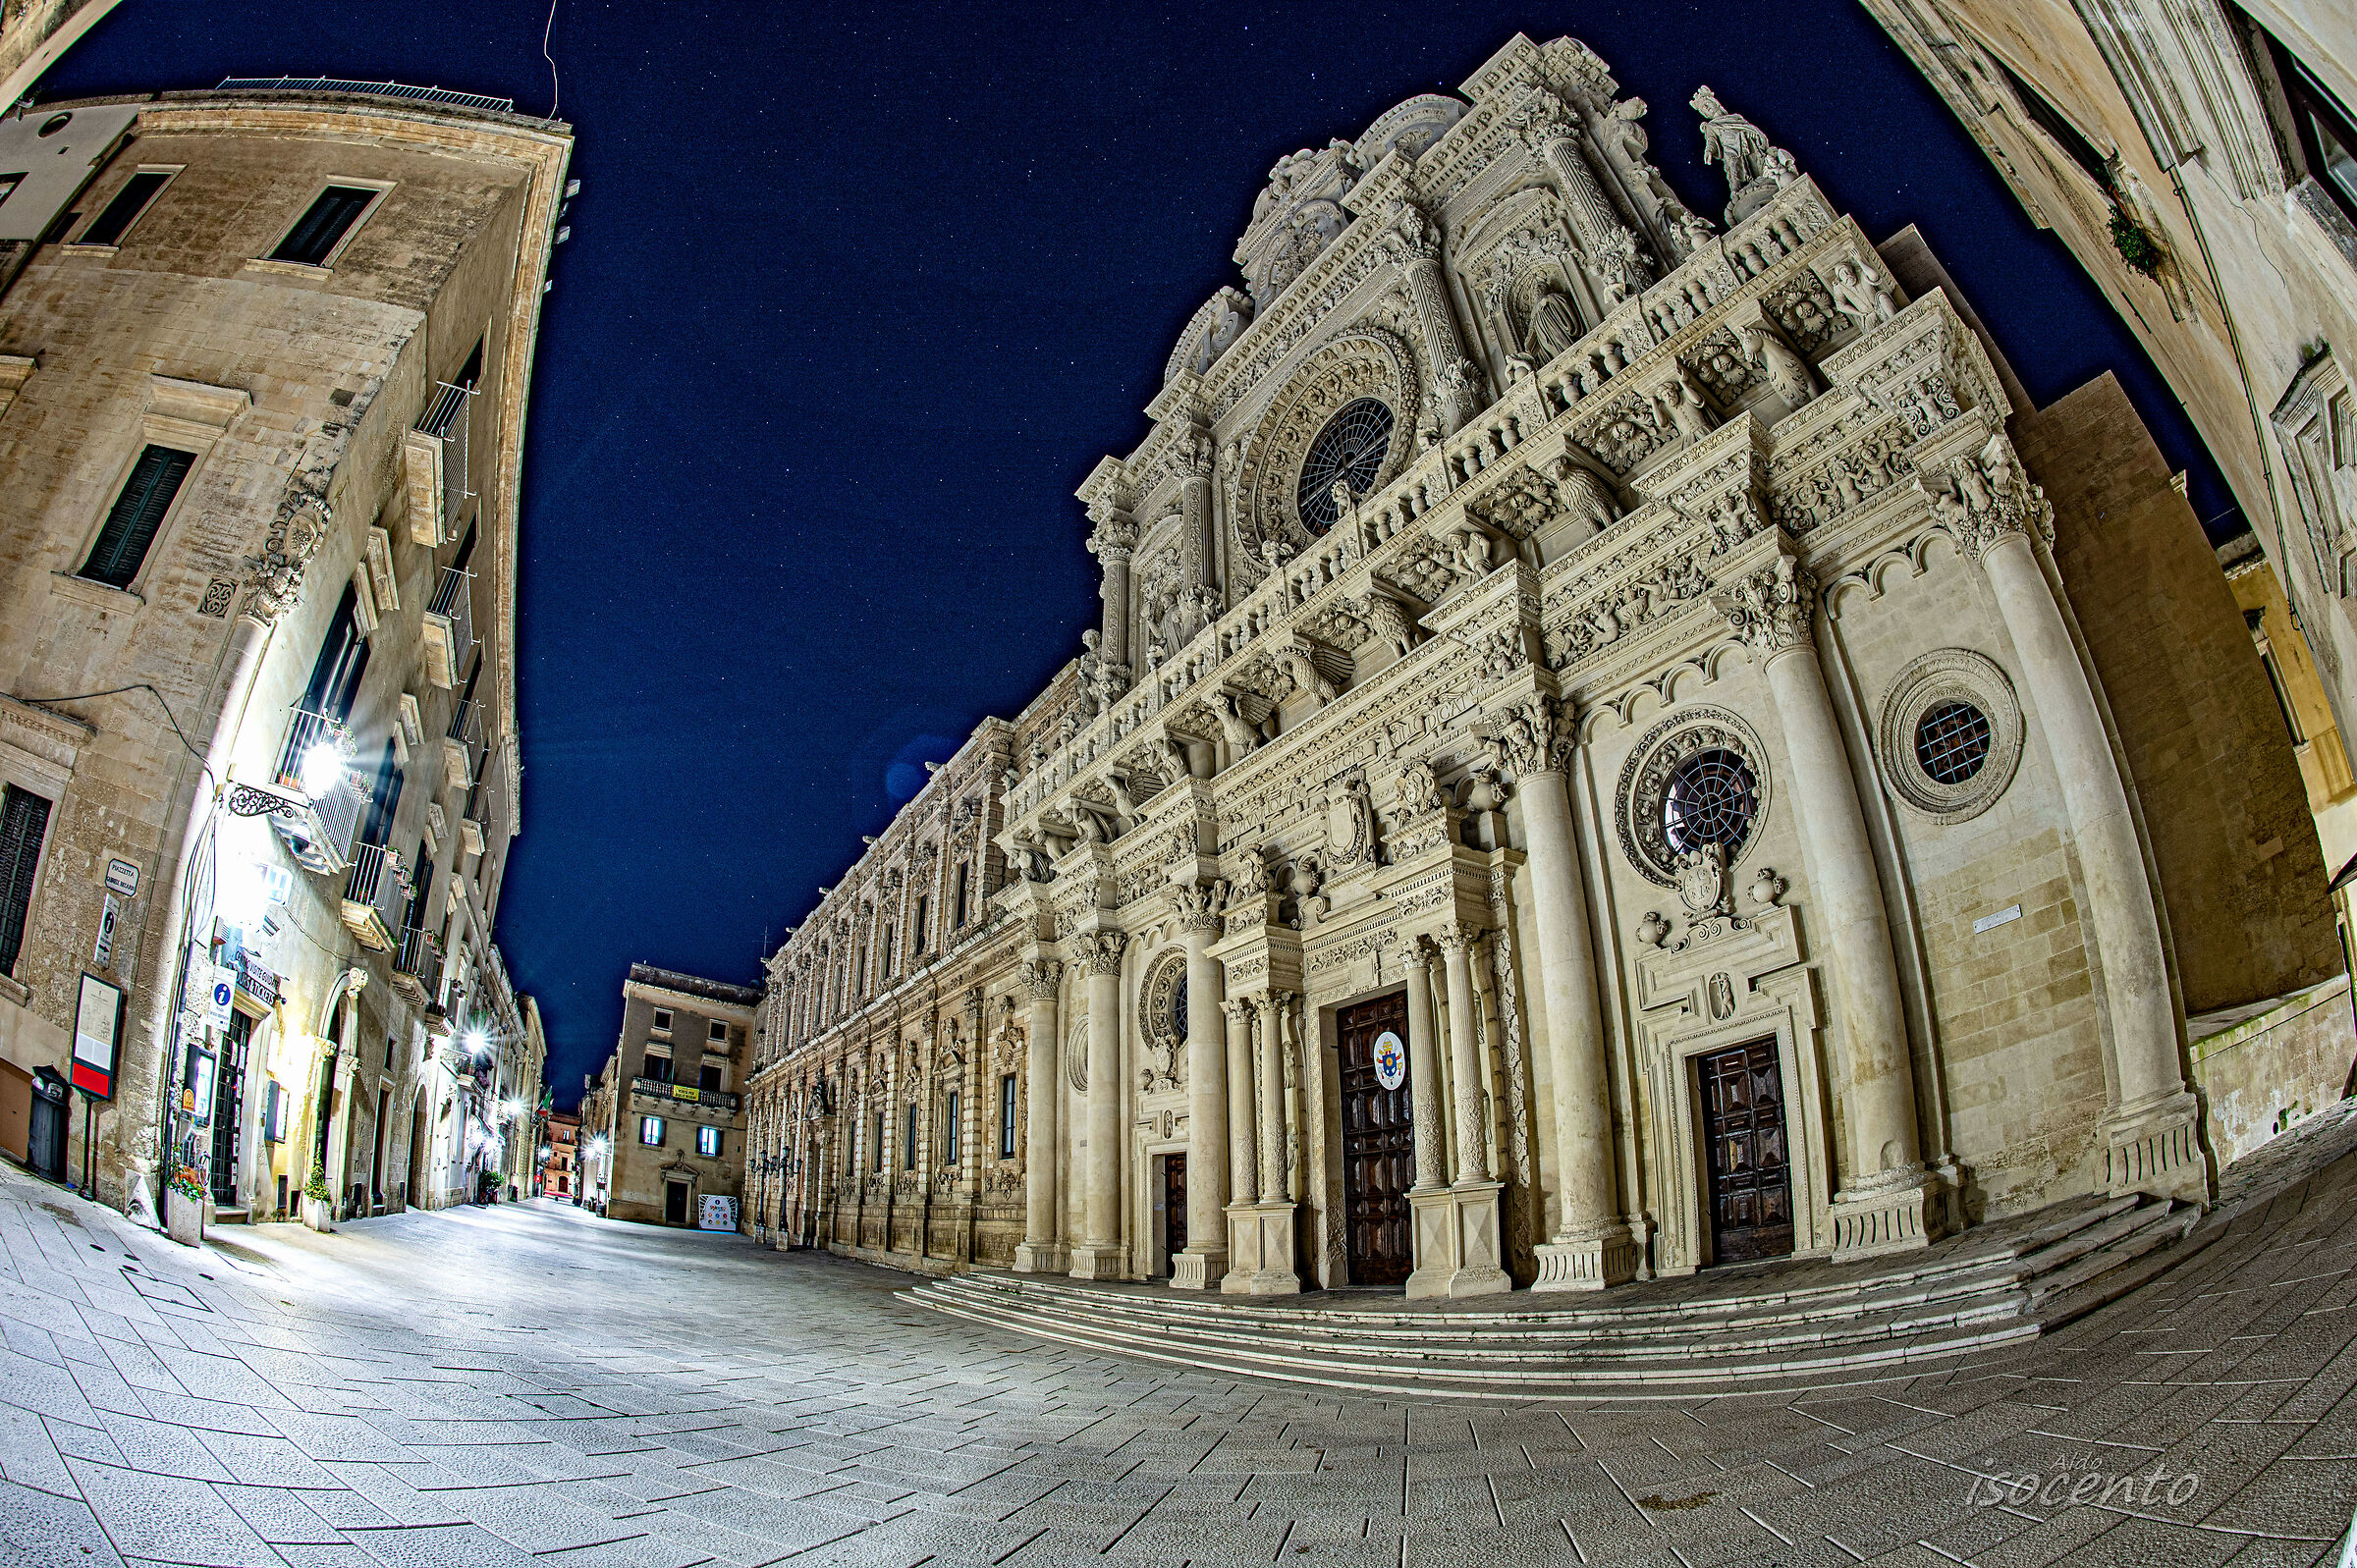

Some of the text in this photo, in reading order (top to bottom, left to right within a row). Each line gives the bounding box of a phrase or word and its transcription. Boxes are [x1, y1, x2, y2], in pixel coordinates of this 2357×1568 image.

[111, 864, 135, 879] PIAZZETTA
[236, 950, 250, 969] CENTRO
[249, 961, 263, 978] VISITE
[253, 982, 276, 1005] TICKETS
